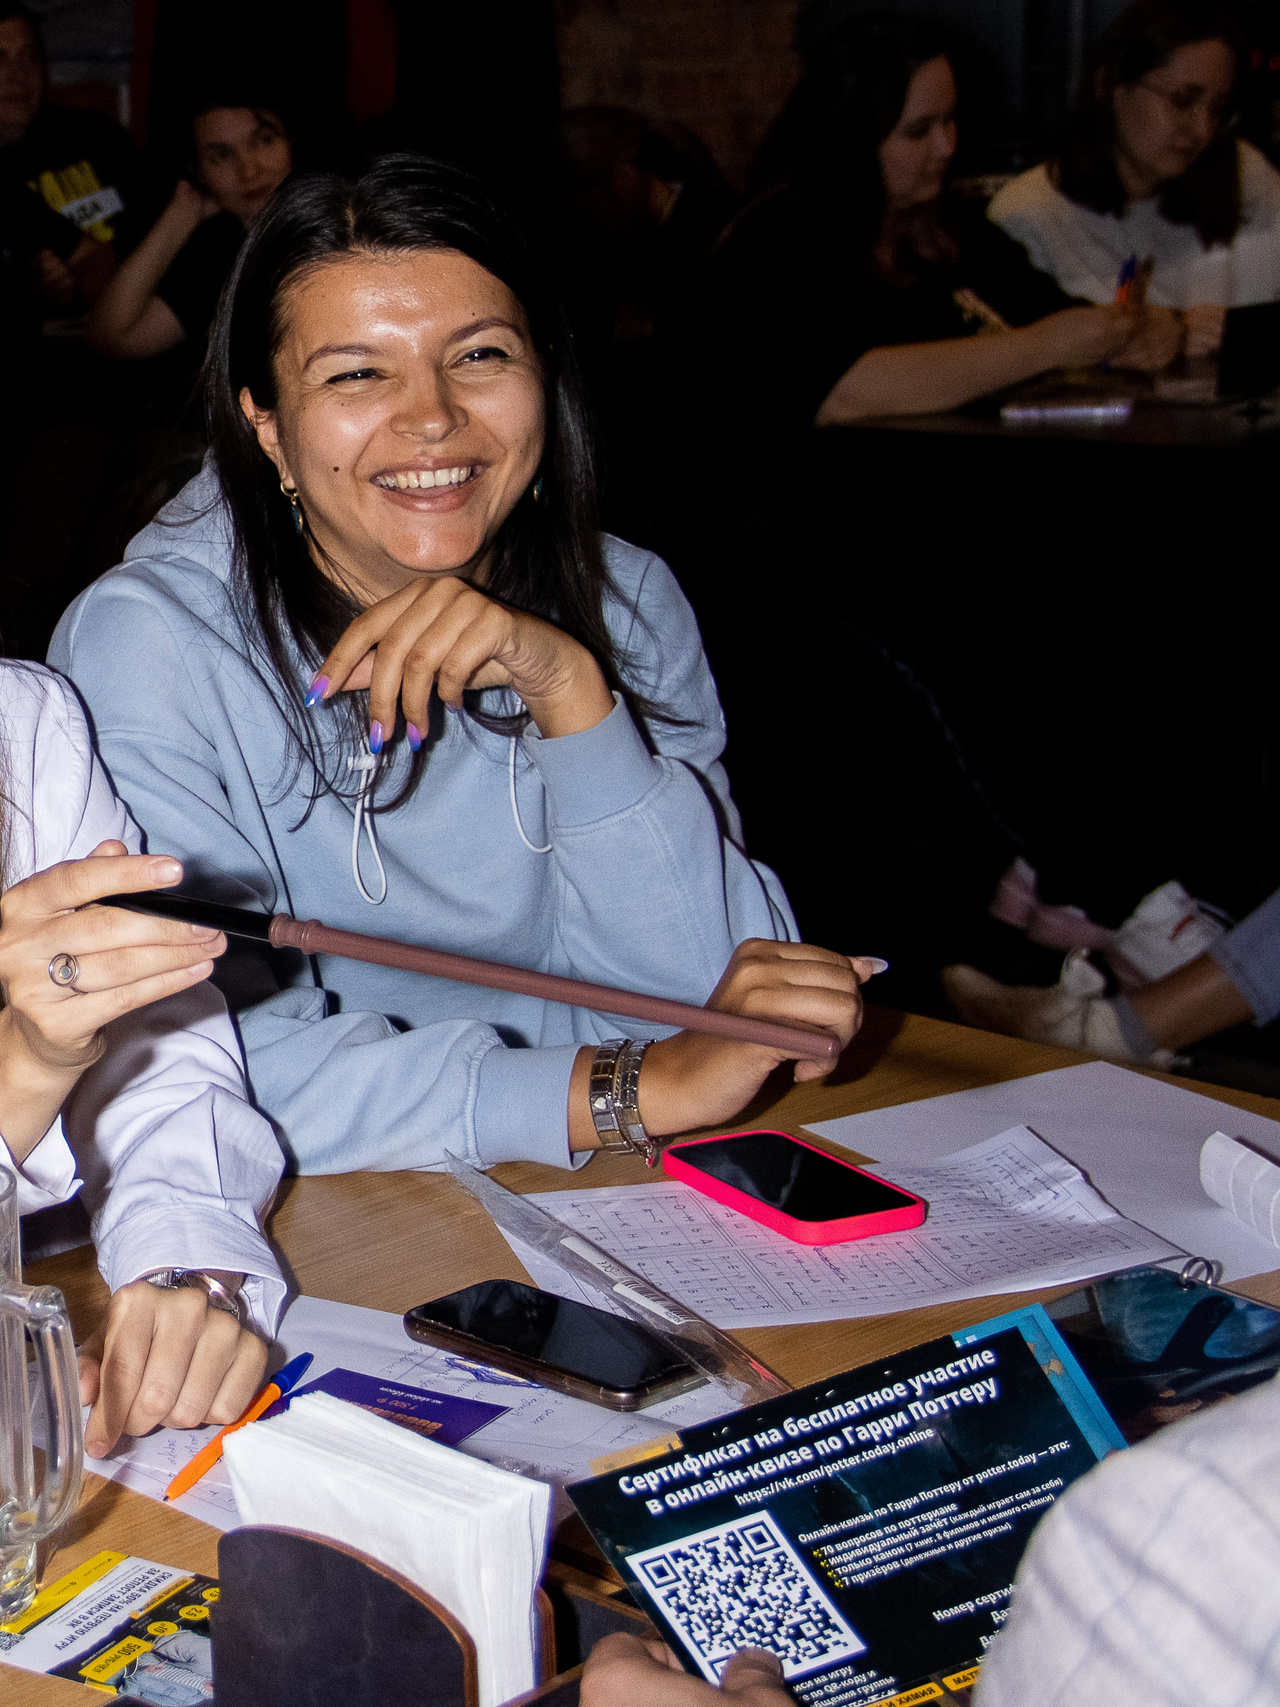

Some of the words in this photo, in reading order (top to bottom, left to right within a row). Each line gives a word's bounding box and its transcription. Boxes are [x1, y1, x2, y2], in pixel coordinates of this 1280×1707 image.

[619, 1439, 751, 1494] Сертификат
[754, 1429, 783, 1447] на
[784, 1383, 907, 1436] бесплатное
[908, 1351, 995, 1396] участие
[646, 1500, 663, 1514] в
[665, 1447, 813, 1507] онлайн-квизе
[814, 1437, 842, 1455] по
[842, 1412, 908, 1444] Гарри
[908, 1378, 996, 1420] Поттеру
[735, 1429, 934, 1505] https://vk.com/potter.today.online
[799, 1512, 874, 1543] Онлайн-квизы
[874, 1508, 887, 1517] по
[887, 1496, 919, 1512] Гарри
[919, 1481, 961, 1501] Поттеру
[962, 1476, 974, 1485] от
[976, 1453, 1036, 1483] potter.today
[1048, 1441, 1070, 1454] это:
[820, 1545, 834, 1555] 70
[835, 1530, 883, 1551] вопросов
[884, 1525, 897, 1534] по
[898, 1504, 957, 1529] поттериане
[828, 1527, 919, 1565] индивидуальный
[919, 1518, 948, 1533] зачёт
[949, 1505, 987, 1523] (каждый
[987, 1496, 1013, 1510] играет
[1015, 1490, 1031, 1499] сам
[1041, 1478, 1063, 1490] себя)
[835, 1558, 872, 1574] только
[873, 1546, 905, 1562] канон
[905, 1543, 912, 1552] (7
[914, 1537, 937, 1547] книг,
[943, 1521, 980, 1539] фильмов
[987, 1507, 1021, 1522] немного
[1021, 1493, 1055, 1510] съёмки)
[842, 1577, 849, 1585] 7
[851, 1561, 900, 1583] призёров
[900, 1546, 946, 1566] (денежные
[954, 1533, 982, 1548] другие
[983, 1522, 1011, 1537] призы)
[145, 1567, 161, 1575] ЗА
[117, 1574, 153, 1595] РЕПОСТ
[136, 1571, 173, 1593] СКИДКА
[86, 1593, 120, 1616] ЗАПИСИ
[109, 1603, 124, 1613] НА
[123, 1593, 142, 1605] 50%
[932, 1601, 975, 1621] Номер
[66, 1618, 83, 1628] ВК
[75, 1611, 112, 1636] ПЕРВУЮ
[54, 1633, 79, 1651] ИГРУ
[117, 1642, 142, 1656] 500
[810, 1689, 824, 1698] по
[823, 1673, 867, 1692] QR-коду
[867, 1670, 876, 1678] и
[814, 1675, 828, 1684] на
[827, 1665, 853, 1679] игру
[856, 1676, 895, 1694] группы
[952, 1669, 979, 1685] МАТ
[896, 1686, 937, 1706] ХИМИЯ
